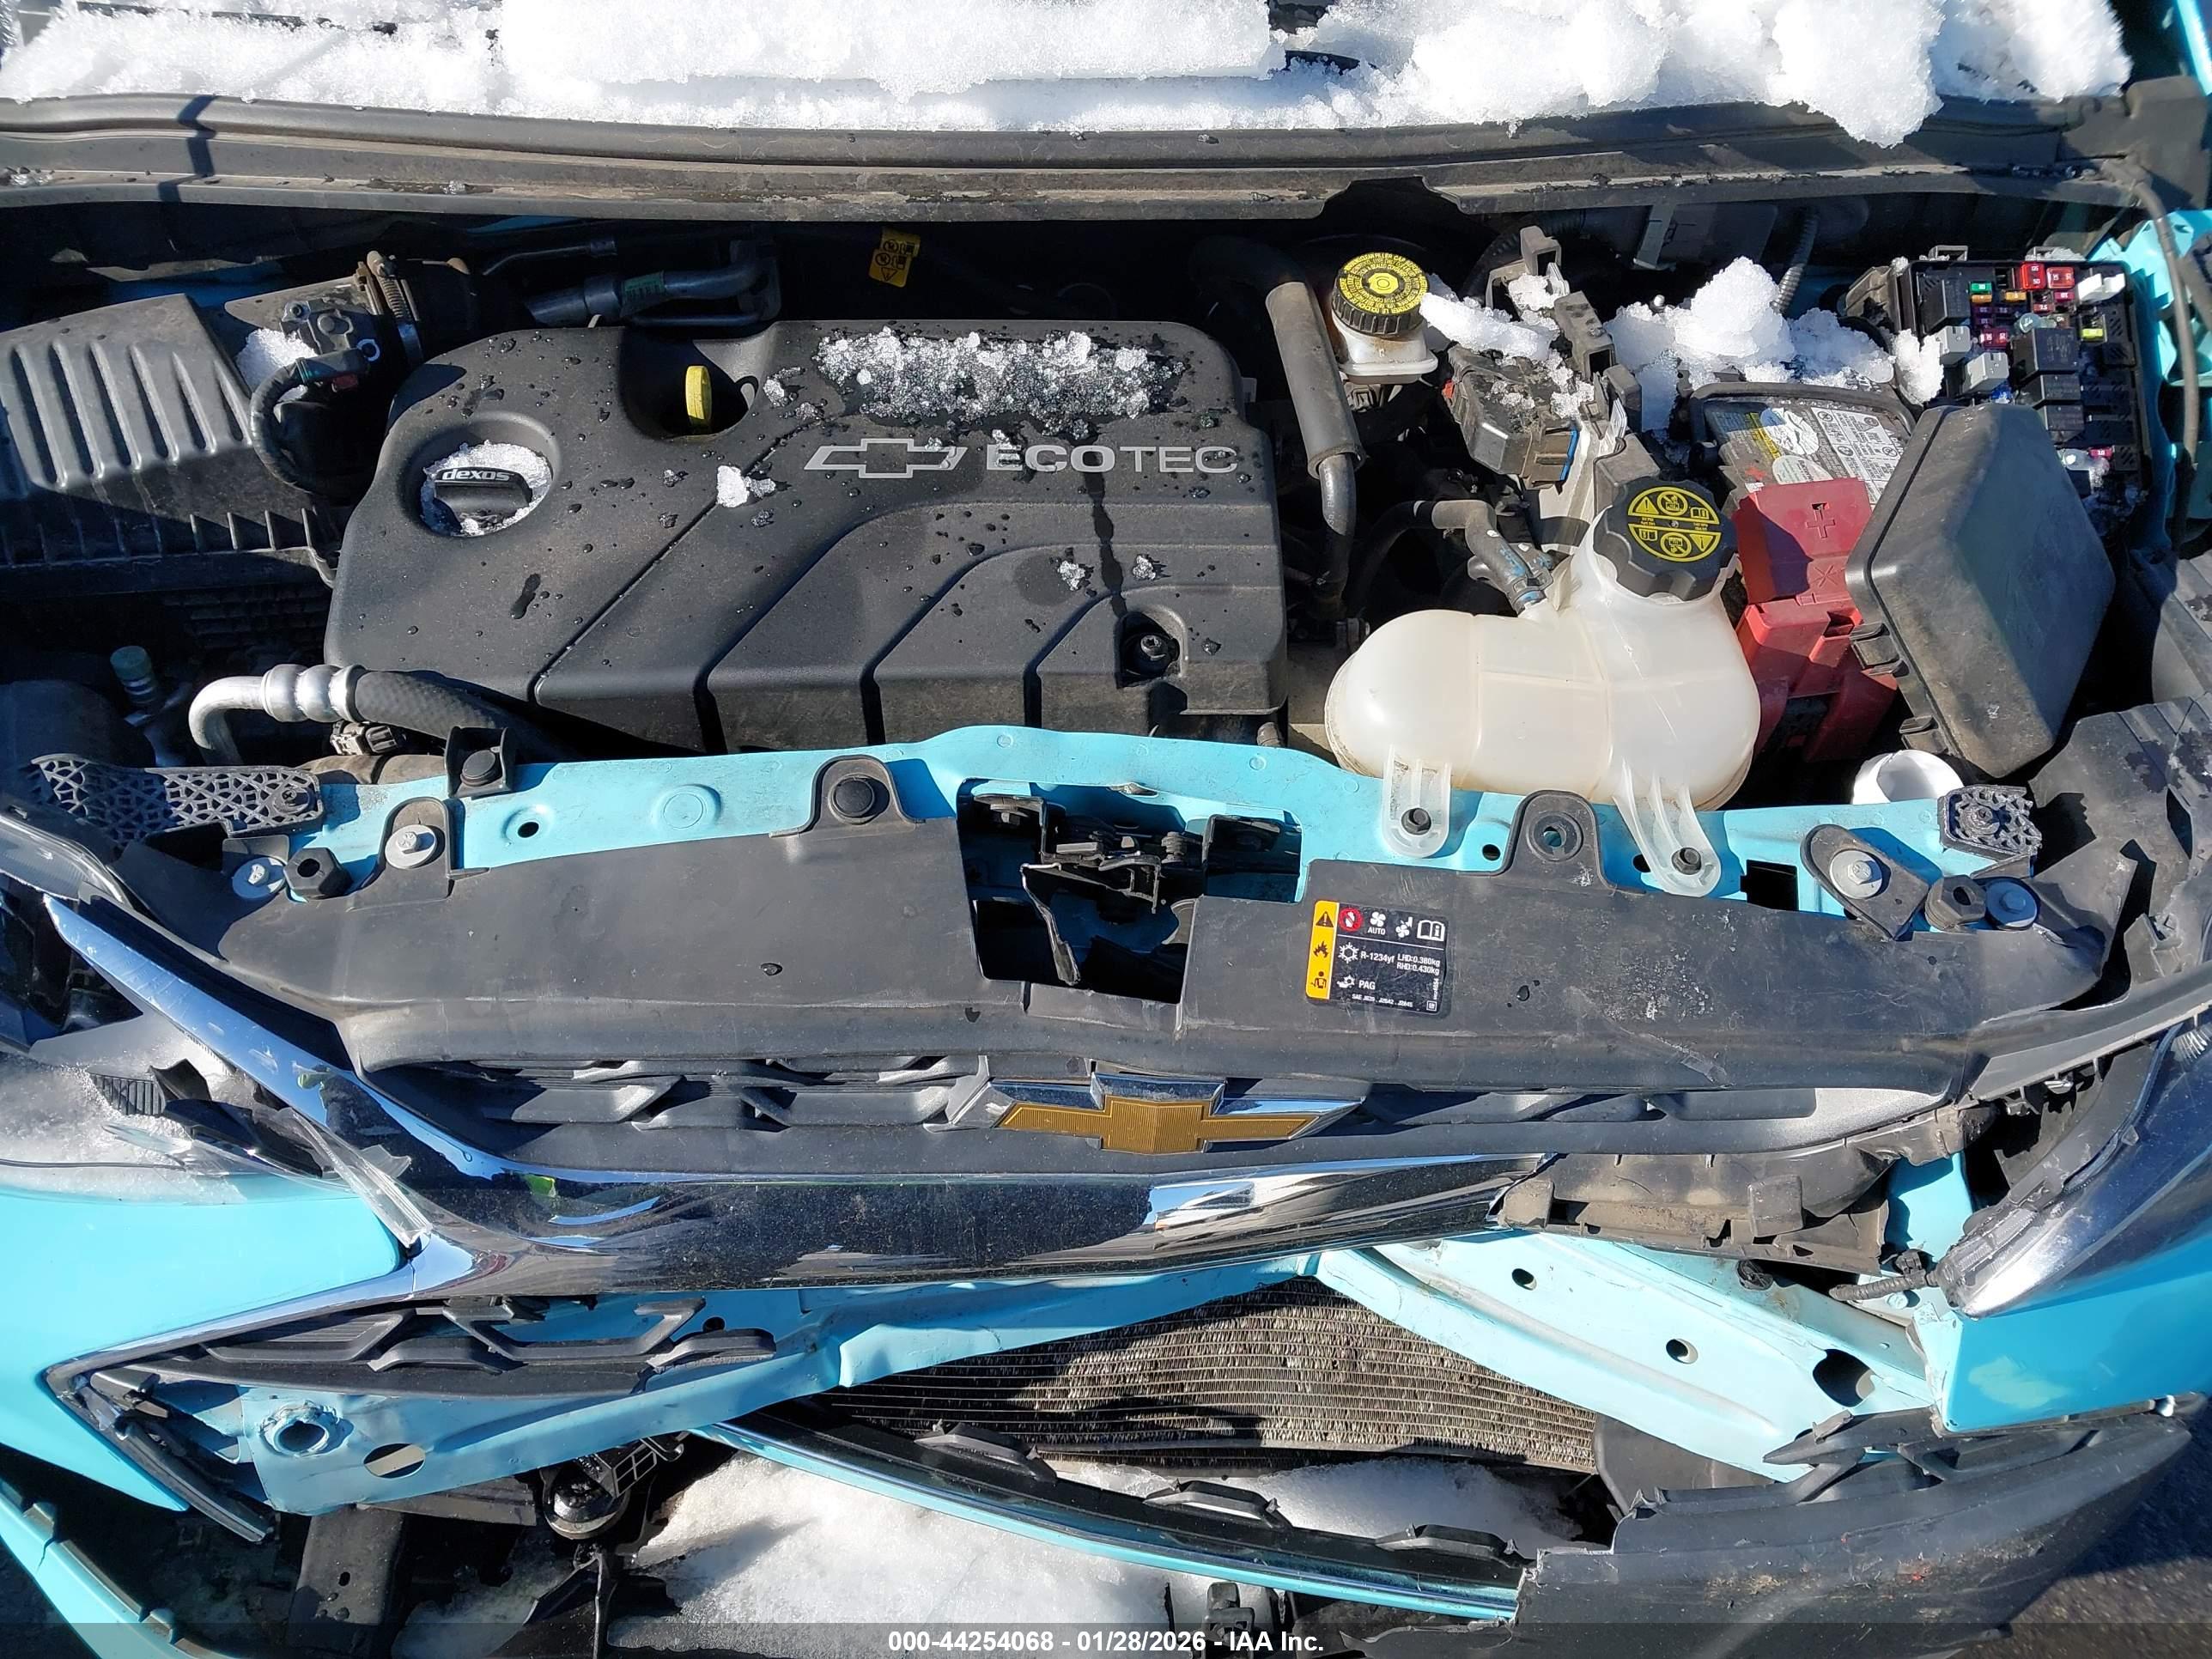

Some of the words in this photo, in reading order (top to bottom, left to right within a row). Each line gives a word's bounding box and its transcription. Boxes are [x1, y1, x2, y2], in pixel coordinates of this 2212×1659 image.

[986, 444, 1237, 473] ECOTEC
[441, 469, 510, 482] dexos
[1367, 927, 1386, 935] AUTO
[1360, 951, 1395, 964] R-1234yf
[1358, 980, 1376, 990] PAG
